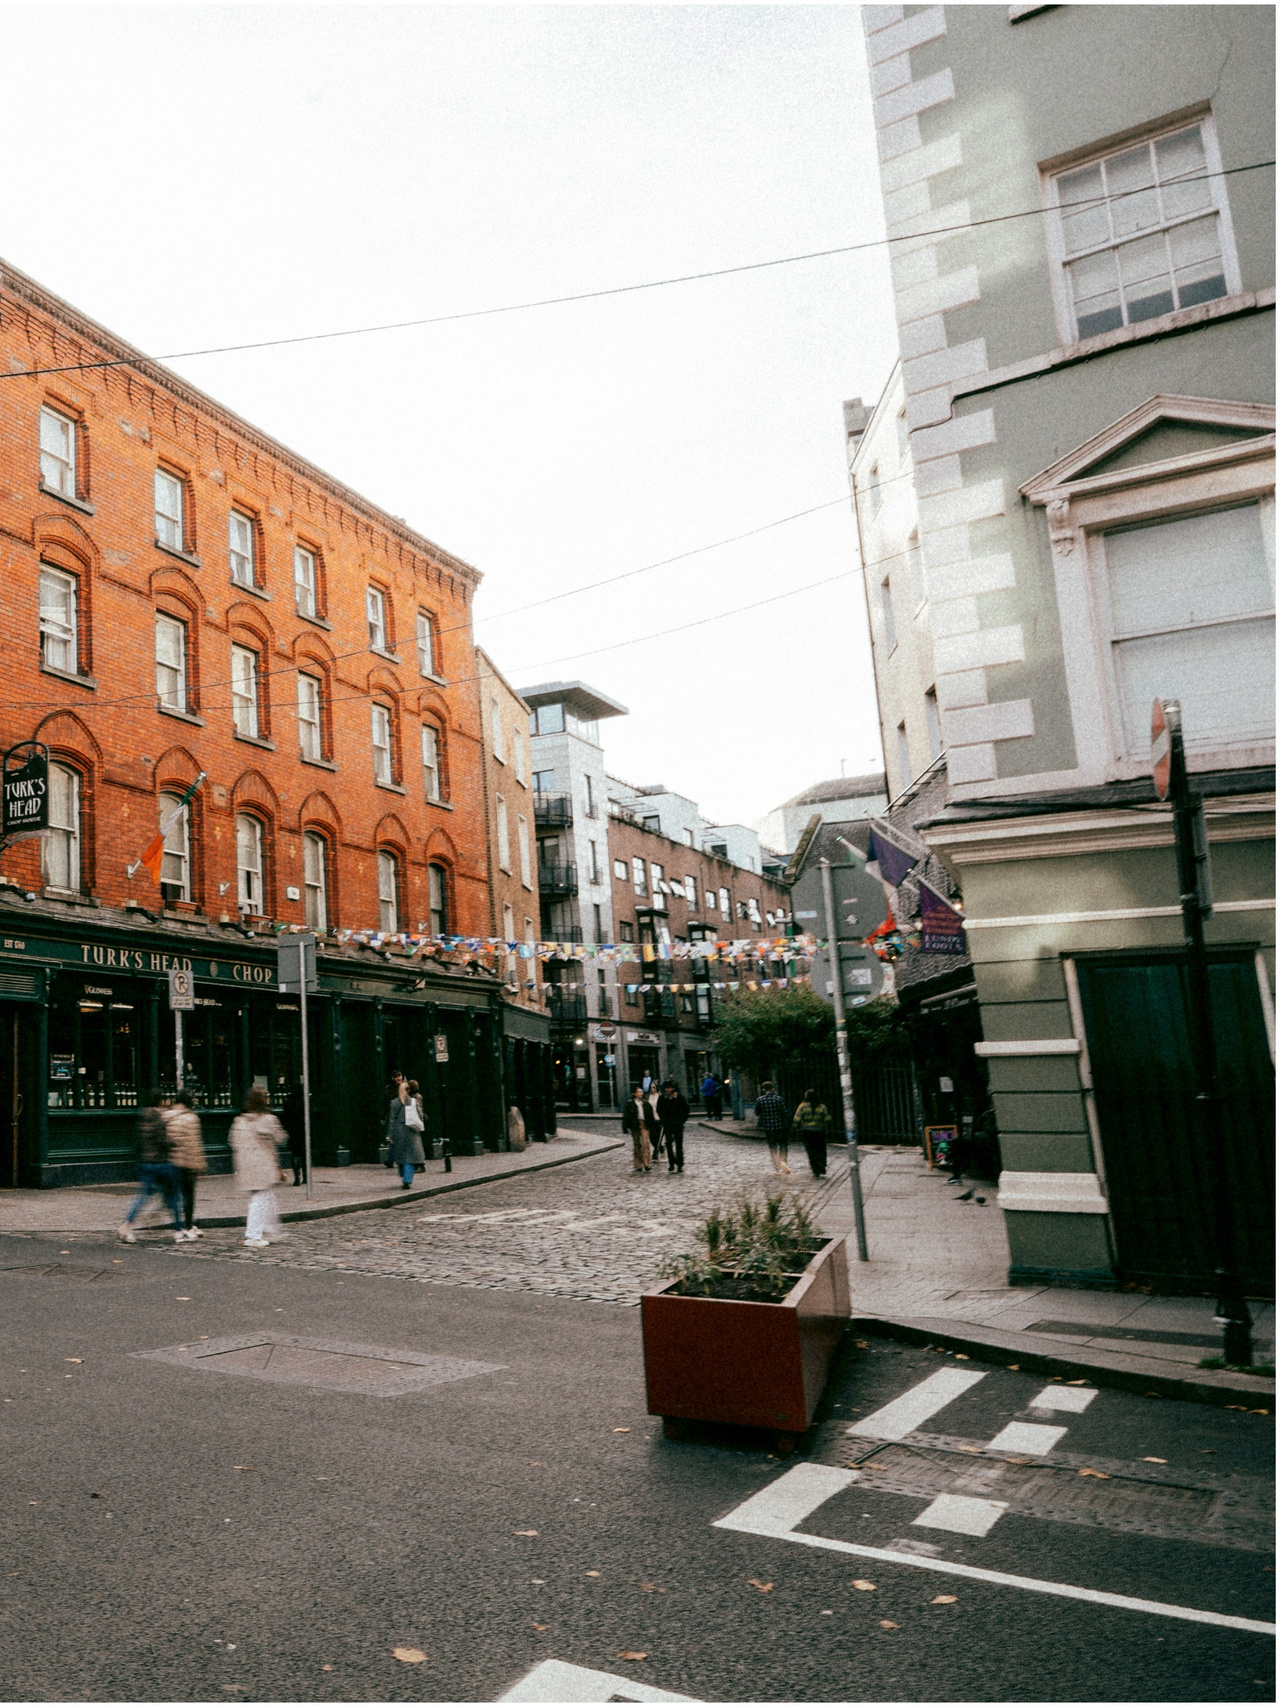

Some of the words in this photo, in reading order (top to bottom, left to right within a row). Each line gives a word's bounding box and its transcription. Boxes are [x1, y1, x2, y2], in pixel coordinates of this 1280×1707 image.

[5, 778, 46, 800] TURK'S
[9, 798, 41, 818] HEAD
[81, 945, 143, 969] TURK'S
[150, 953, 192, 972] HEAD
[233, 964, 273, 983] CHOP
